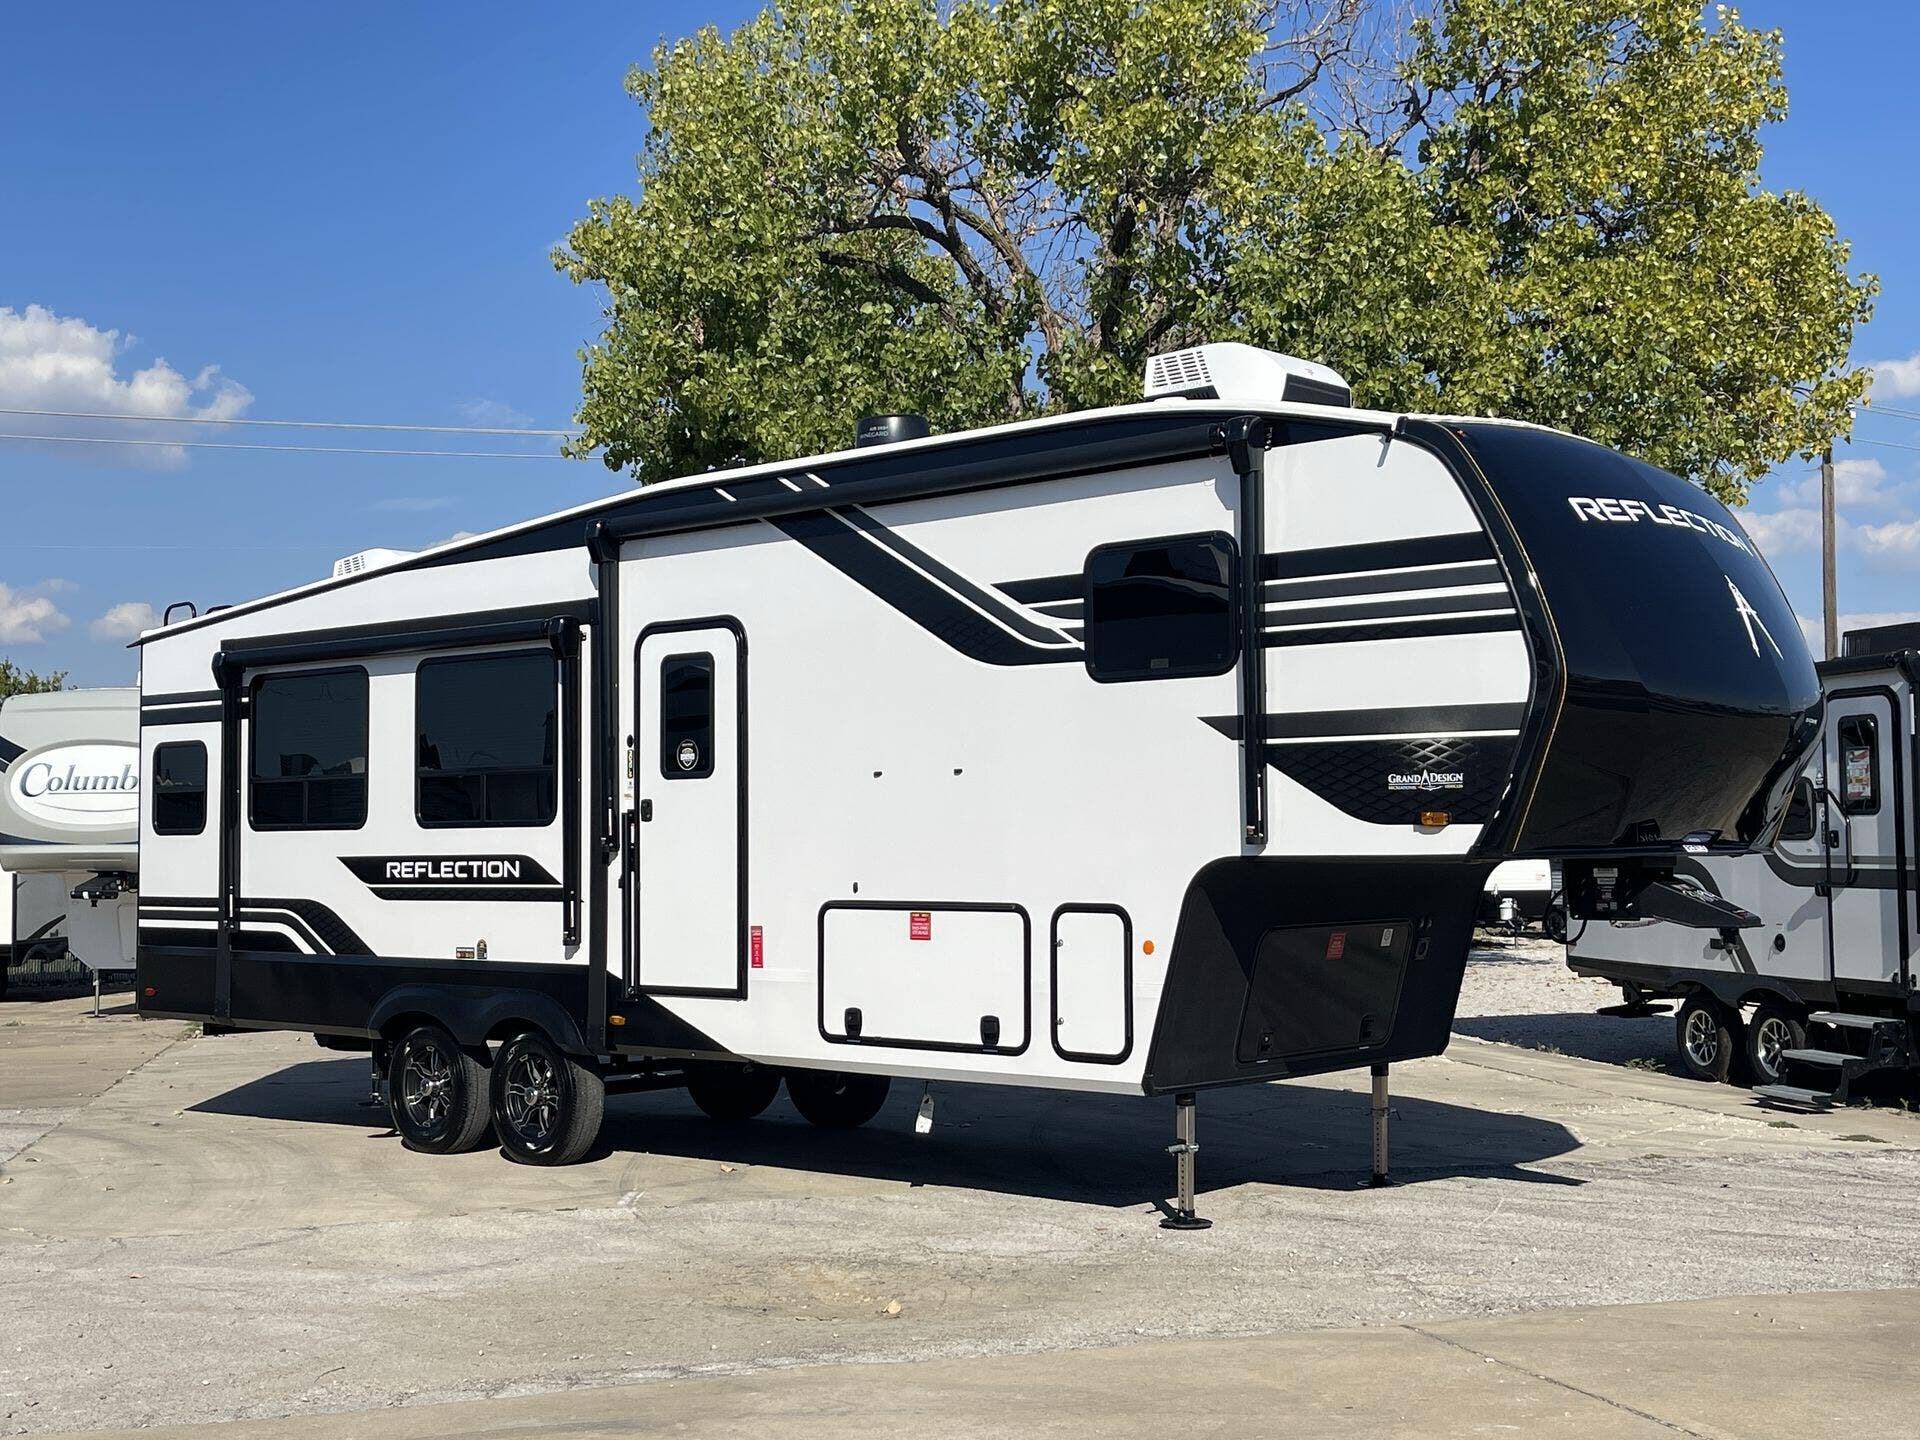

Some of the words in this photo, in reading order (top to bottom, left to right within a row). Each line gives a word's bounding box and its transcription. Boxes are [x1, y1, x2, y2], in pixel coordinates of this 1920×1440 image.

[1567, 497, 1754, 557] REFLECTION
[20, 763, 138, 797] Columb
[1388, 774, 1421, 783] GRAND
[1429, 773, 1464, 782] DESIGN
[386, 860, 520, 878] REFLECTION
